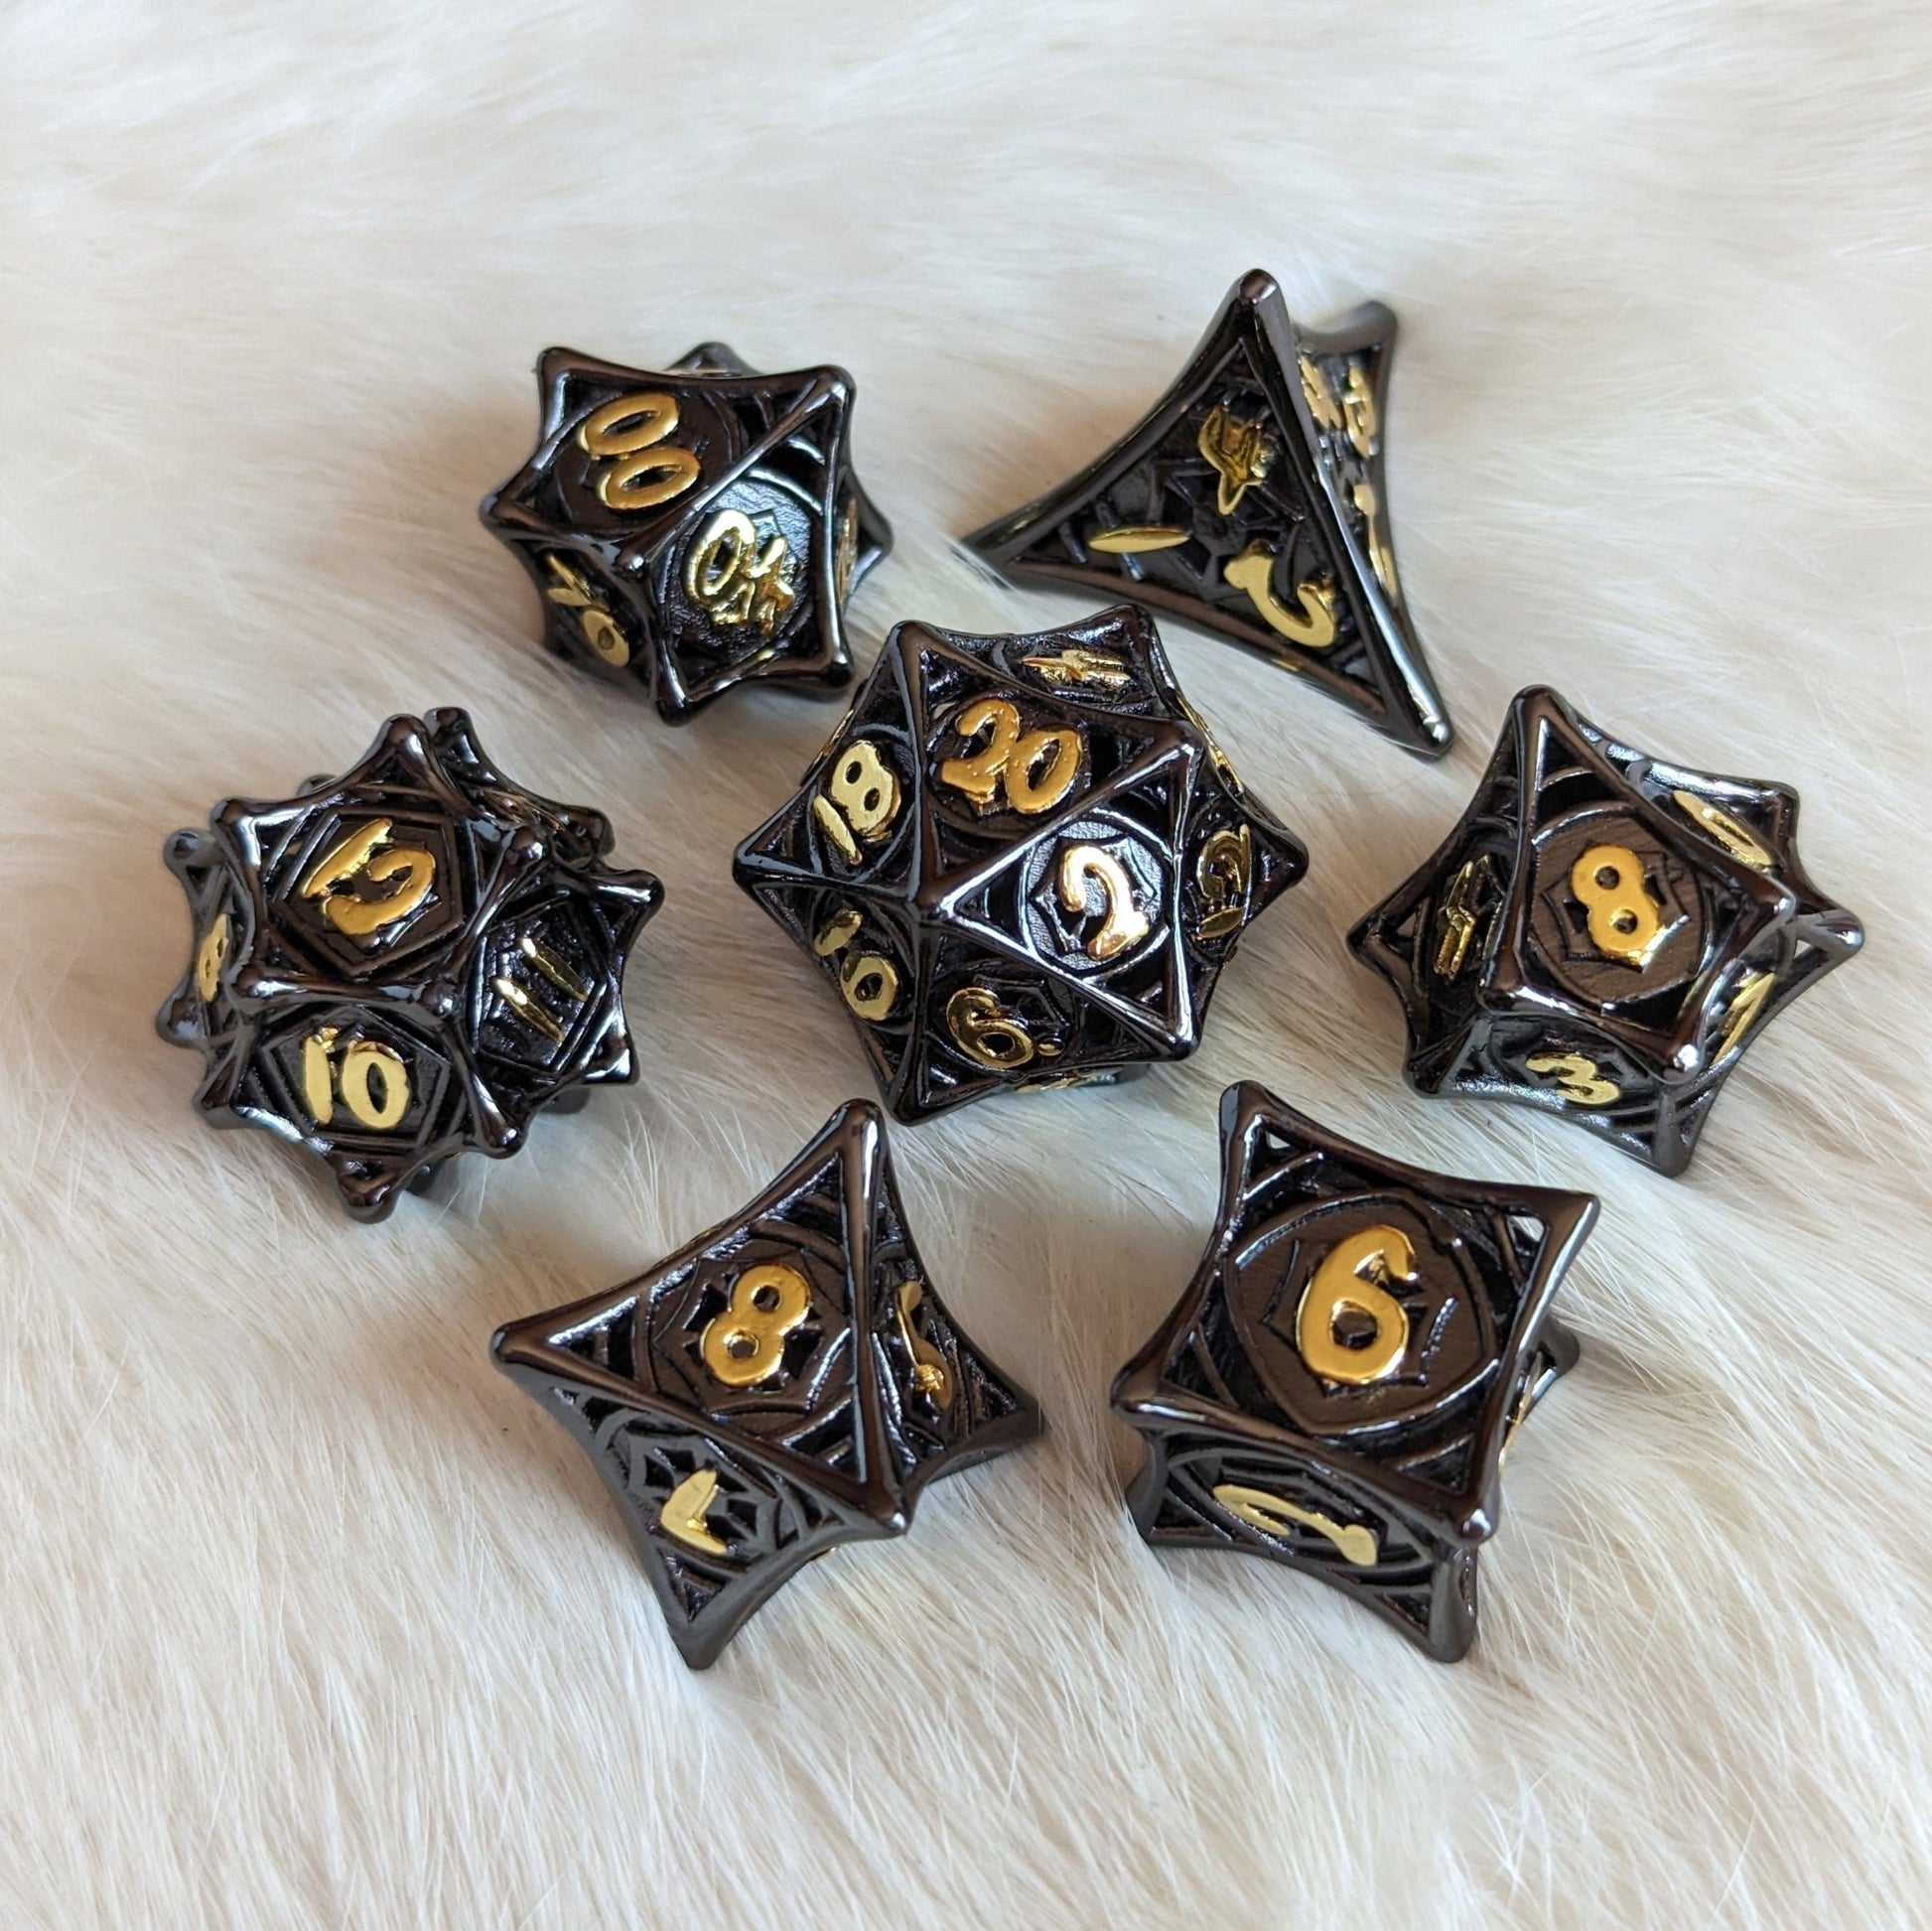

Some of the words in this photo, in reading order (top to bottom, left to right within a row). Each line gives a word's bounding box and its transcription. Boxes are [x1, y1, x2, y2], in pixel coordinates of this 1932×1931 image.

[577, 391, 701, 510] 00
[813, 740, 901, 866] 18
[941, 698, 1082, 815] 20
[1571, 844, 1664, 960] 8
[302, 1027, 411, 1130] 10
[1525, 1052, 1620, 1106] 3
[701, 1263, 812, 1387] 8
[1297, 1224, 1418, 1385] 6
